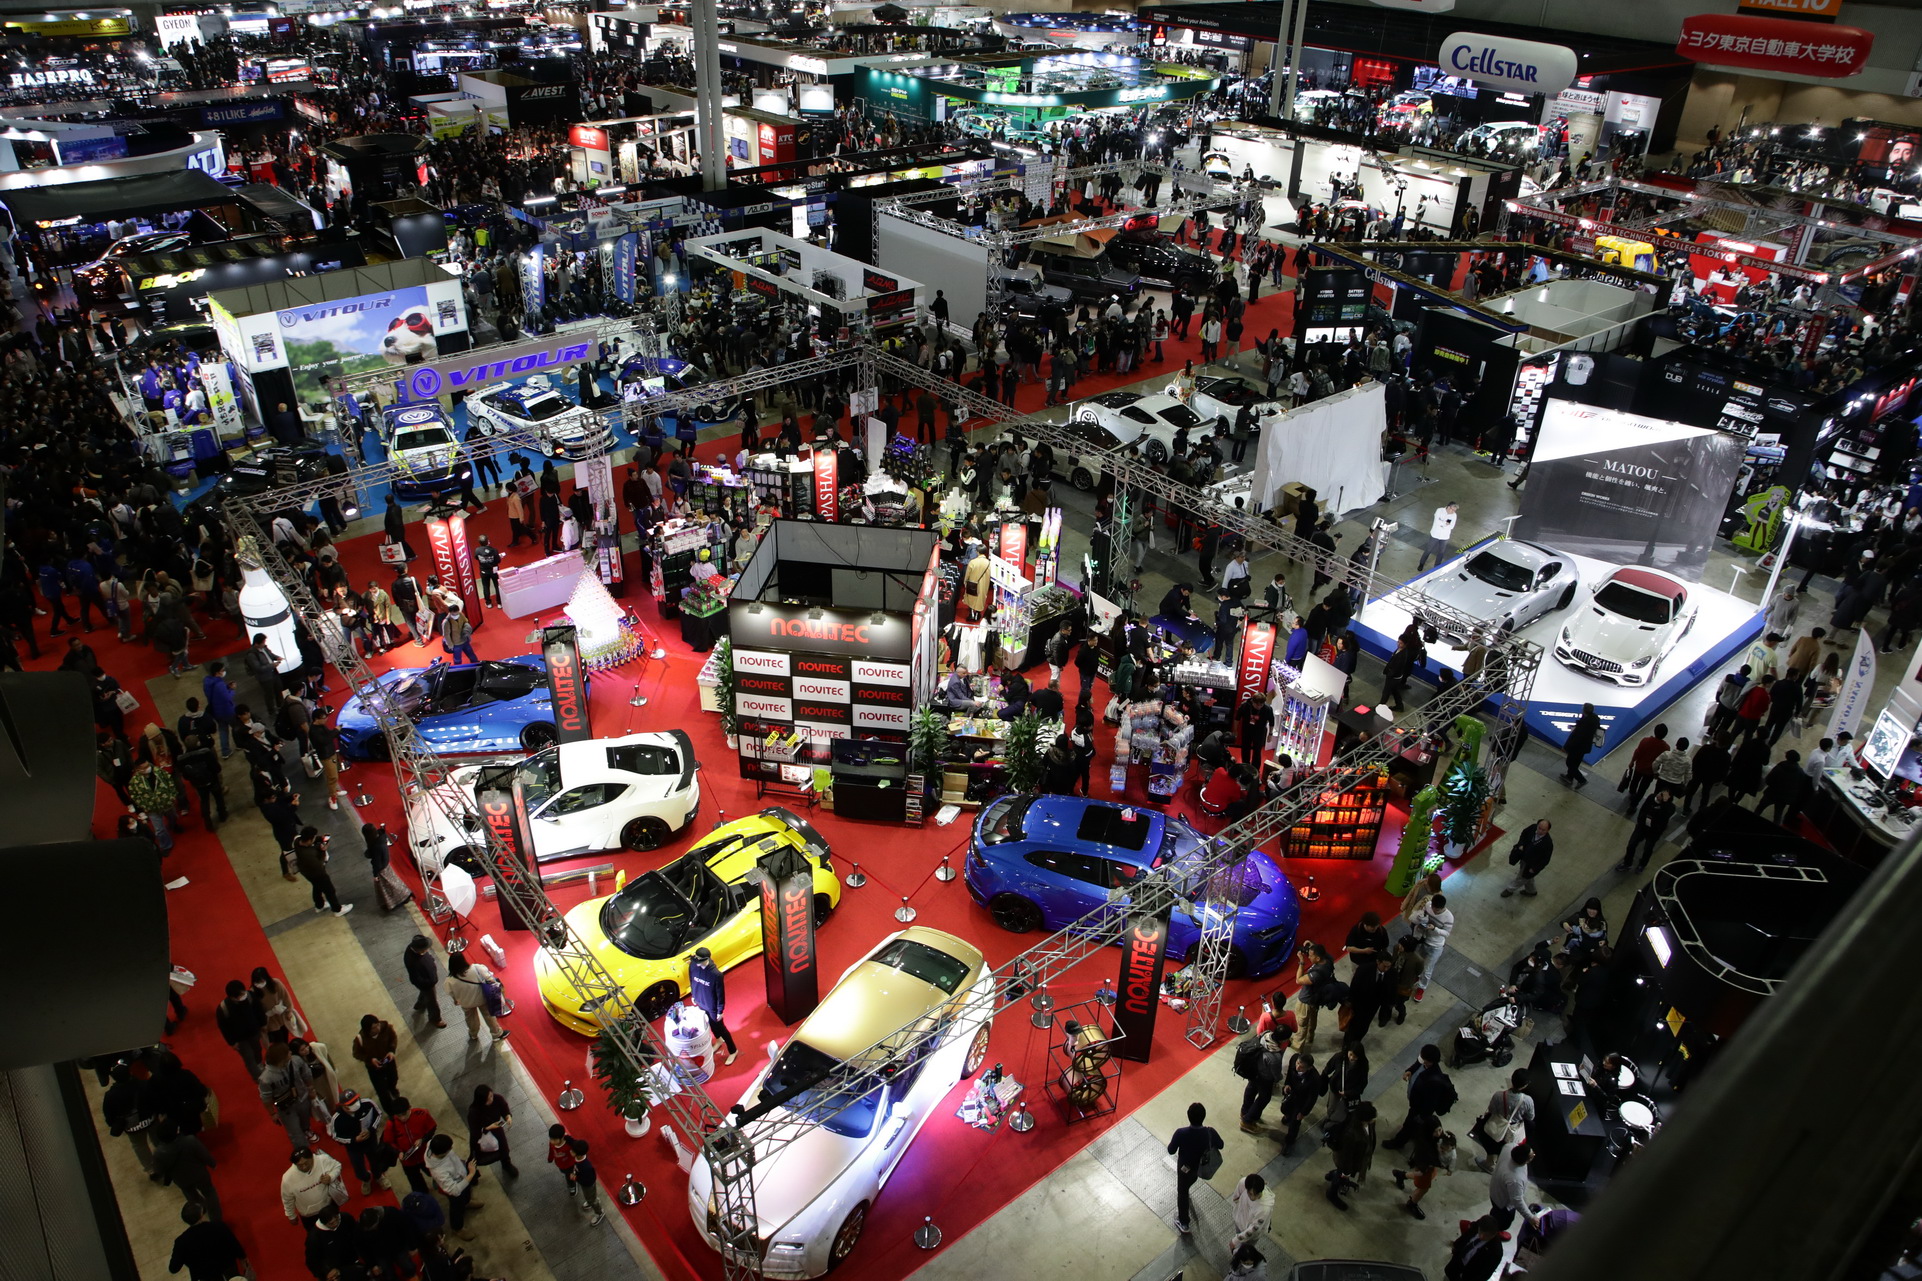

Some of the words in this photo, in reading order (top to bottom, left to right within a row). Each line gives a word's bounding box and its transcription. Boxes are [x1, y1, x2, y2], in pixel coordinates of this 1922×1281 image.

[162, 19, 192, 30] GYEON
[10, 68, 92, 88] HASEPRO
[531, 85, 565, 97] AVEST
[1615, 228, 1661, 246] TECHNICAL
[1663, 238, 1701, 254] COLLEGE
[1702, 247, 1736, 262] TOKYO
[622, 239, 630, 298] VITOUR
[303, 297, 392, 322] VITOUR
[299, 362, 319, 371] Enjoy
[322, 359, 338, 367] your
[449, 342, 589, 385] VITOUR
[1603, 459, 1659, 480] MATOU
[770, 618, 869, 643] NOVITEC
[739, 656, 784, 669] NOVITEC
[798, 661, 843, 675] NOVITEC
[858, 667, 903, 679] NOVITEC
[741, 678, 785, 692] NOVITEC
[799, 684, 844, 697] NOVITEC
[552, 655, 581, 730] NOVITEC
[858, 689, 903, 702] NOVITEC
[742, 700, 785, 713] NOVITEC
[800, 706, 844, 718] NOVITEC
[859, 711, 903, 723] NOVITEC
[1539, 710, 1577, 718] DESIGN
[762, 879, 781, 974] NOVITEC
[785, 889, 810, 974] NOVITEC
[1125, 928, 1159, 1014] NOVITEC
